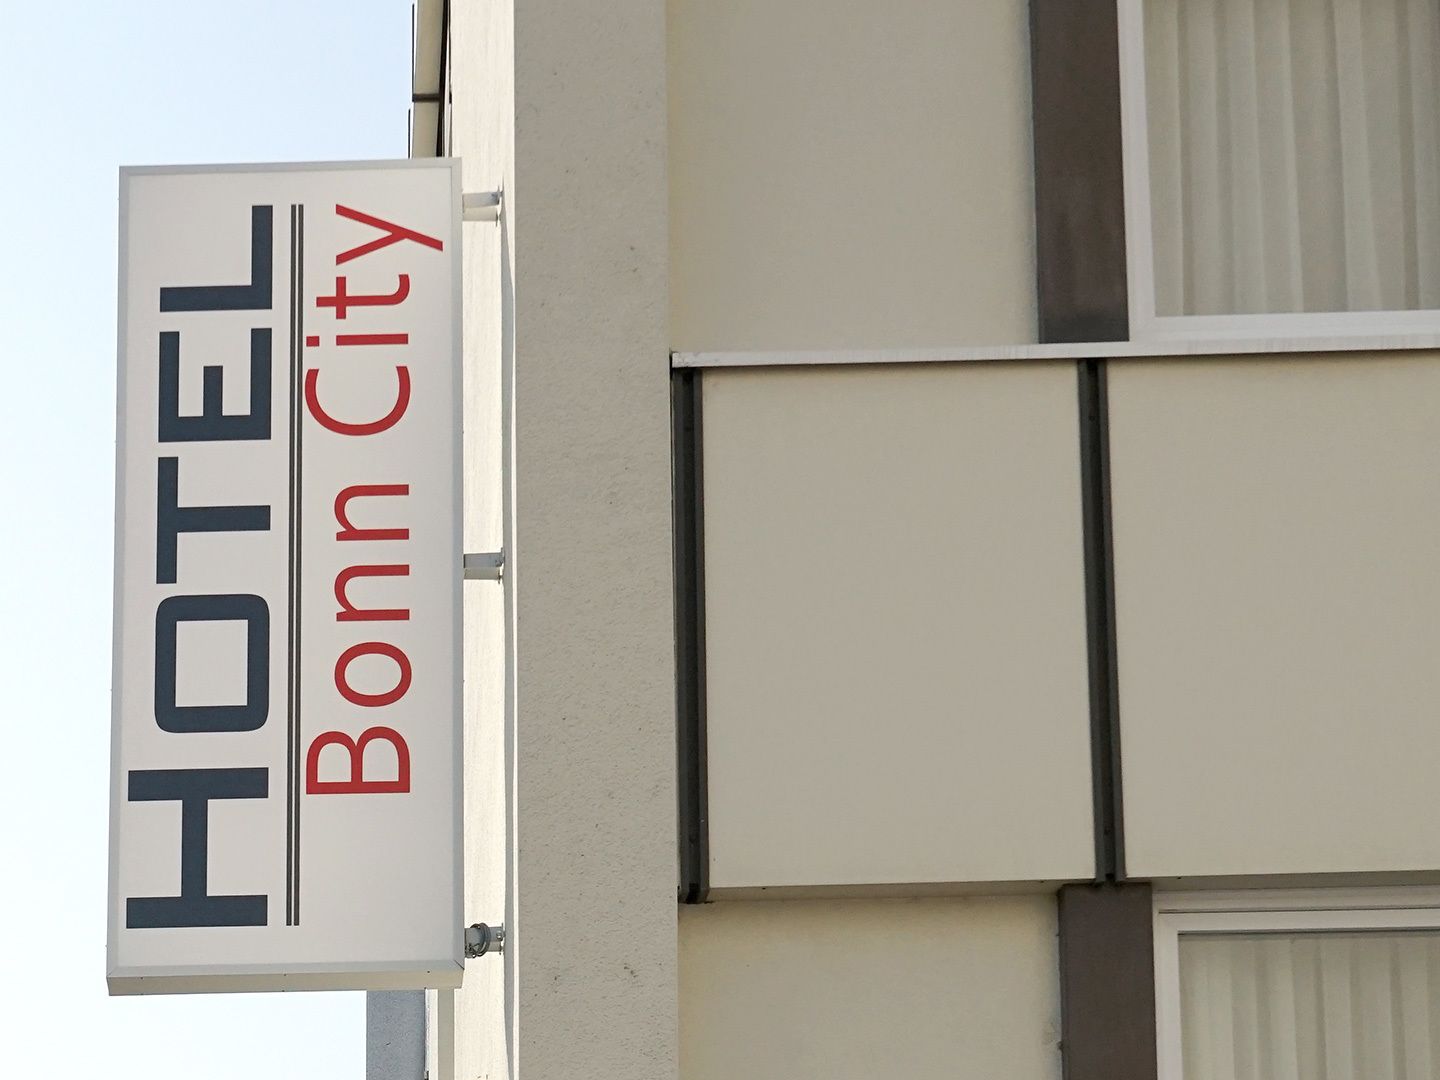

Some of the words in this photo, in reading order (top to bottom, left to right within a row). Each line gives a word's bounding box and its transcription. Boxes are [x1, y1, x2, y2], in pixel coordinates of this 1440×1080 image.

[304, 203, 444, 437] City
[126, 204, 274, 929] HOTEL
[305, 483, 413, 796] Bonn
